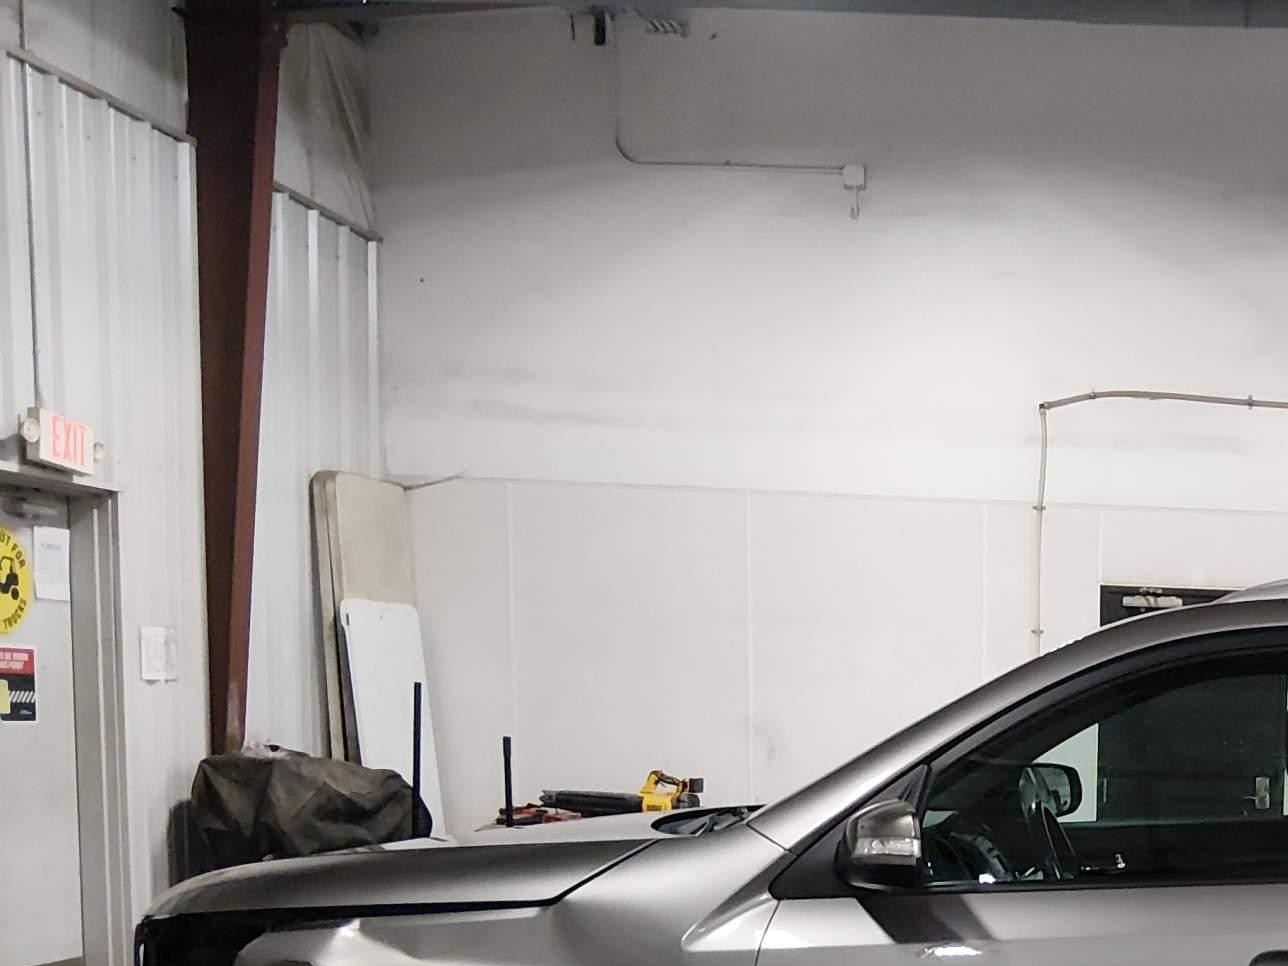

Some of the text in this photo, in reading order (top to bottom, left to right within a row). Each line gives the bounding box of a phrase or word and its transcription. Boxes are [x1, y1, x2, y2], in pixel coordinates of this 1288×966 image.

[51, 415, 87, 467] EXIT
[0, 529, 26, 569] UT FOR
[3, 598, 27, 630] TRUCKS
